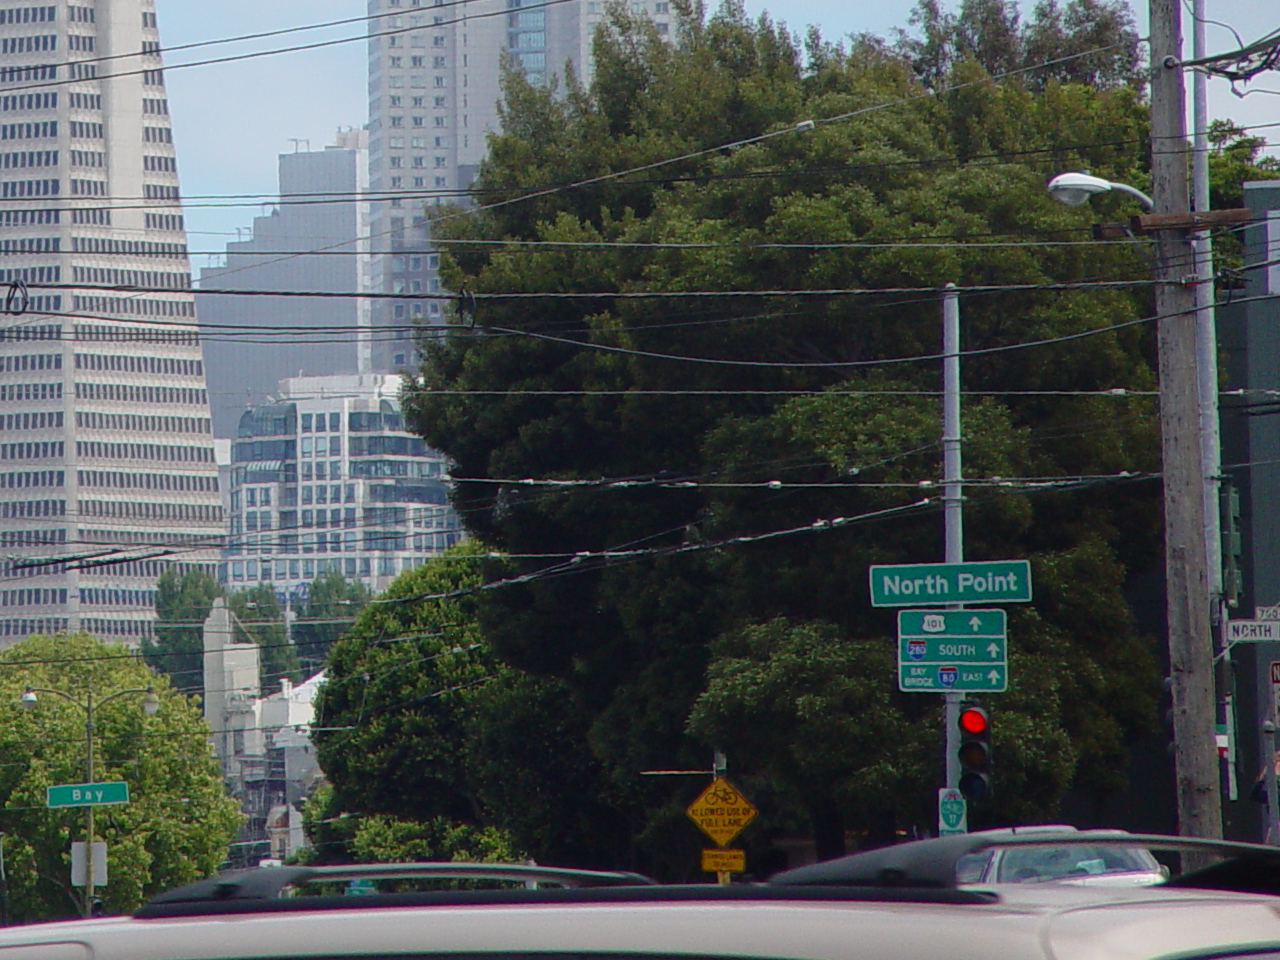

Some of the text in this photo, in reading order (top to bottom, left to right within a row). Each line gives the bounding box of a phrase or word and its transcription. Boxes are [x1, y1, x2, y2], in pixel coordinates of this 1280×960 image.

[882, 571, 1018, 596] North Point
[926, 618, 942, 628] 101
[1232, 624, 1272, 638] NORTH
[910, 645, 927, 656] 280
[938, 644, 976, 657] SOUTH
[910, 667, 927, 676] BAY
[904, 677, 935, 687] BRIDGE
[942, 673, 956, 683] 80
[962, 672, 983, 682] EAST
[72, 789, 104, 802] Bay
